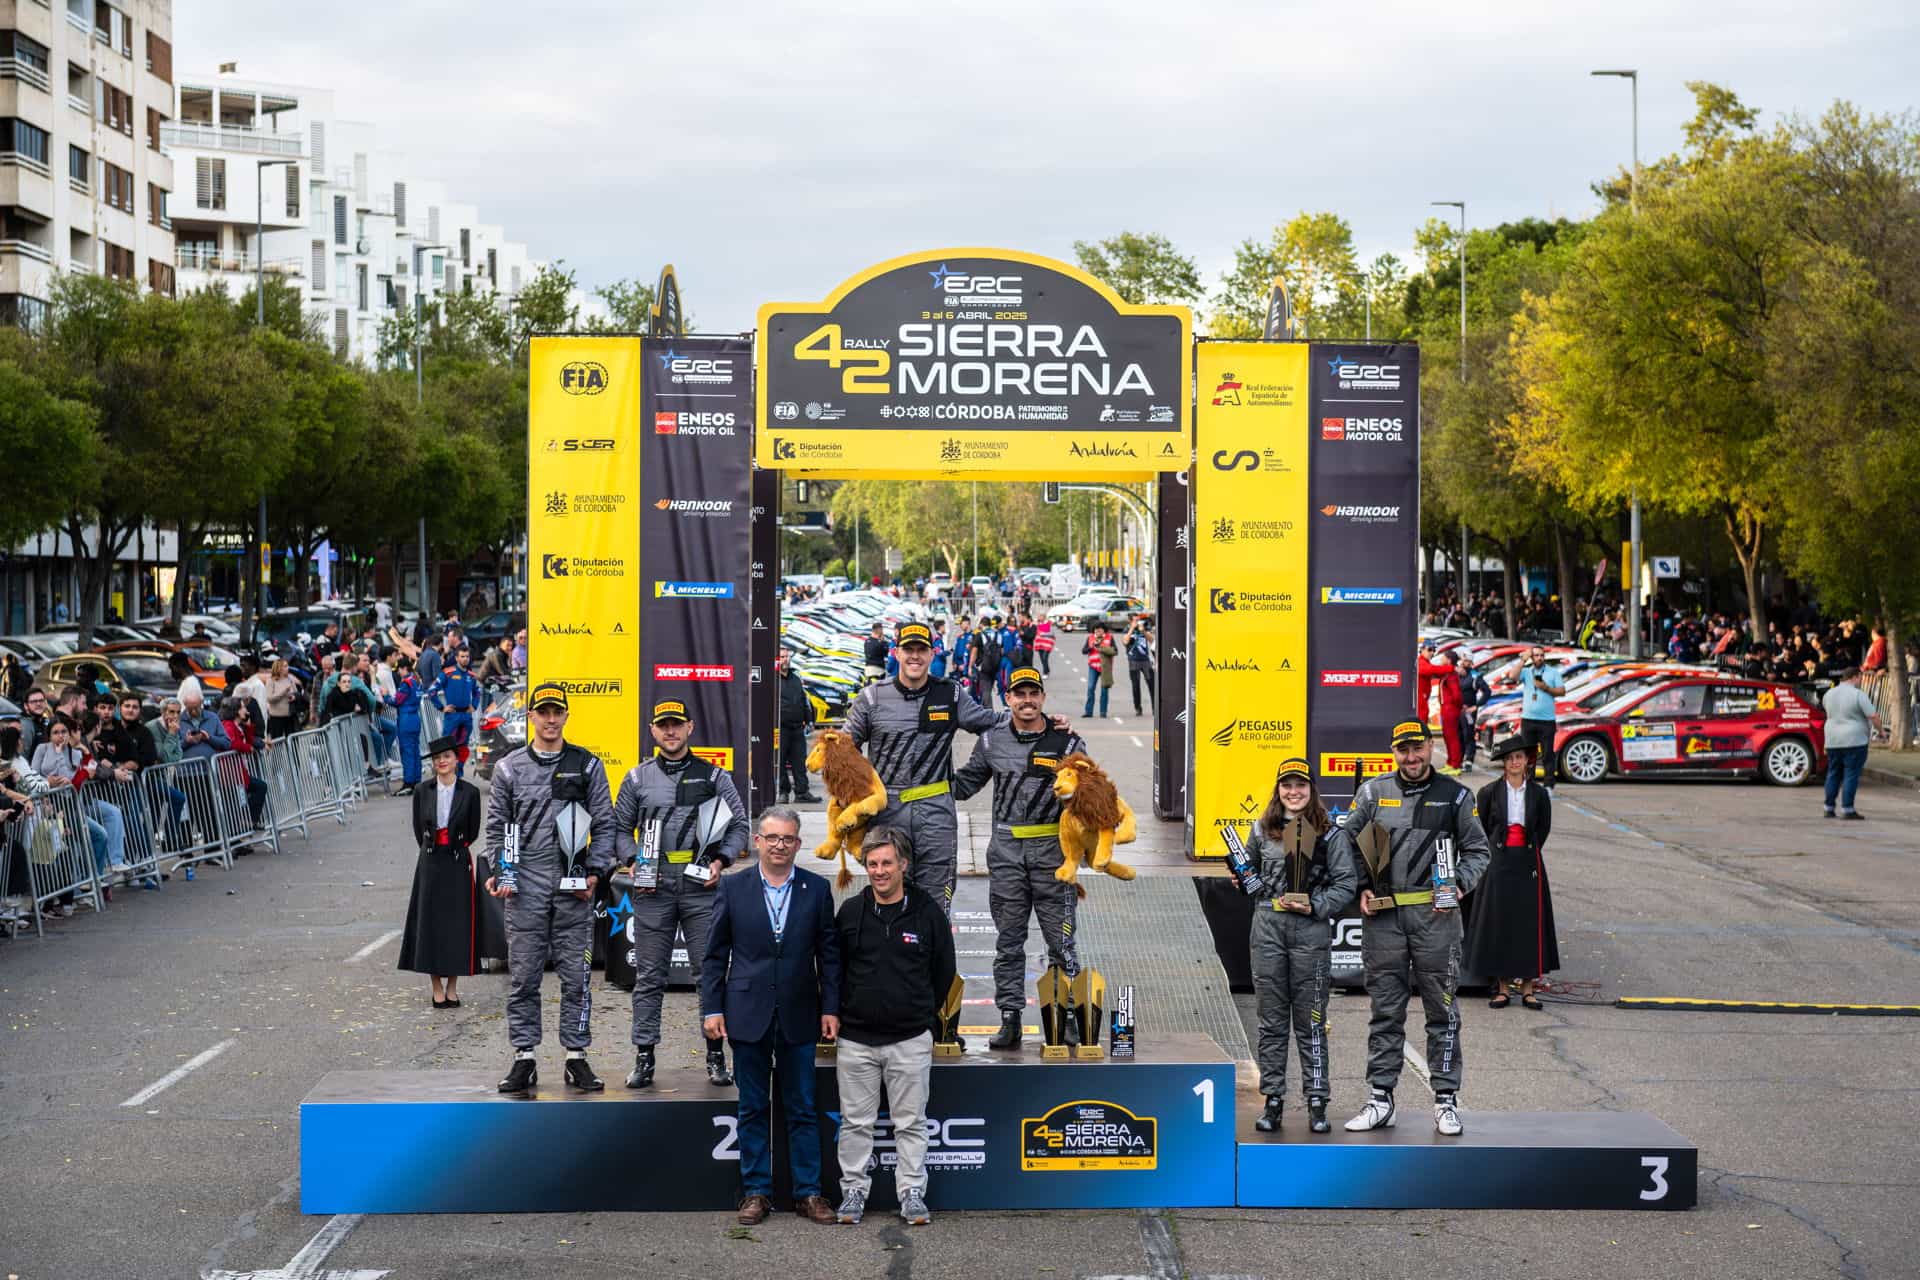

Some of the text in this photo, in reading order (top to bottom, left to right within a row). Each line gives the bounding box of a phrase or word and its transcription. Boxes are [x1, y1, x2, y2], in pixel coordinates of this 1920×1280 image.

[922, 311, 930, 320] 3
[945, 311, 954, 320] 6
[956, 311, 992, 320] ABRIL
[995, 312, 1028, 320] 2025
[844, 339, 889, 349] RALLY
[899, 324, 1107, 358] SIERRA
[899, 362, 1155, 396] MORENA
[935, 402, 1016, 420] CÓRDOBA
[678, 412, 735, 425] ENEOS
[1018, 413, 1069, 421] HUMANIDAD
[1346, 418, 1402, 431] ENEOS
[678, 426, 735, 436] MOTOR OIL
[1346, 432, 1403, 441] MOTOR OIL
[574, 494, 626, 503] AYUNTAMIENTO
[574, 504, 582, 512] DE
[1241, 521, 1293, 530] AYUNTAMIENTO
[1241, 531, 1249, 539] DE
[573, 556, 624, 567] Diputación
[572, 567, 624, 577] de Córdoba
[678, 586, 728, 595] MICHELIN
[1240, 591, 1292, 603] Diputación
[1344, 592, 1395, 600] MICHELIN
[1240, 602, 1292, 612] de Córdoba
[656, 668, 731, 678] MRF TYRES
[1323, 674, 1399, 683] MRF TYRES
[1757, 692, 1775, 709] 23
[1239, 720, 1293, 731] PEGASUS
[1239, 732, 1293, 741] AERO GROUP
[1192, 1079, 1214, 1123] 1
[1065, 1124, 1130, 1135] SIERRA
[712, 1116, 740, 1160] 2
[1065, 1136, 1145, 1147] MORENA
[1639, 1157, 1669, 1201] 3
